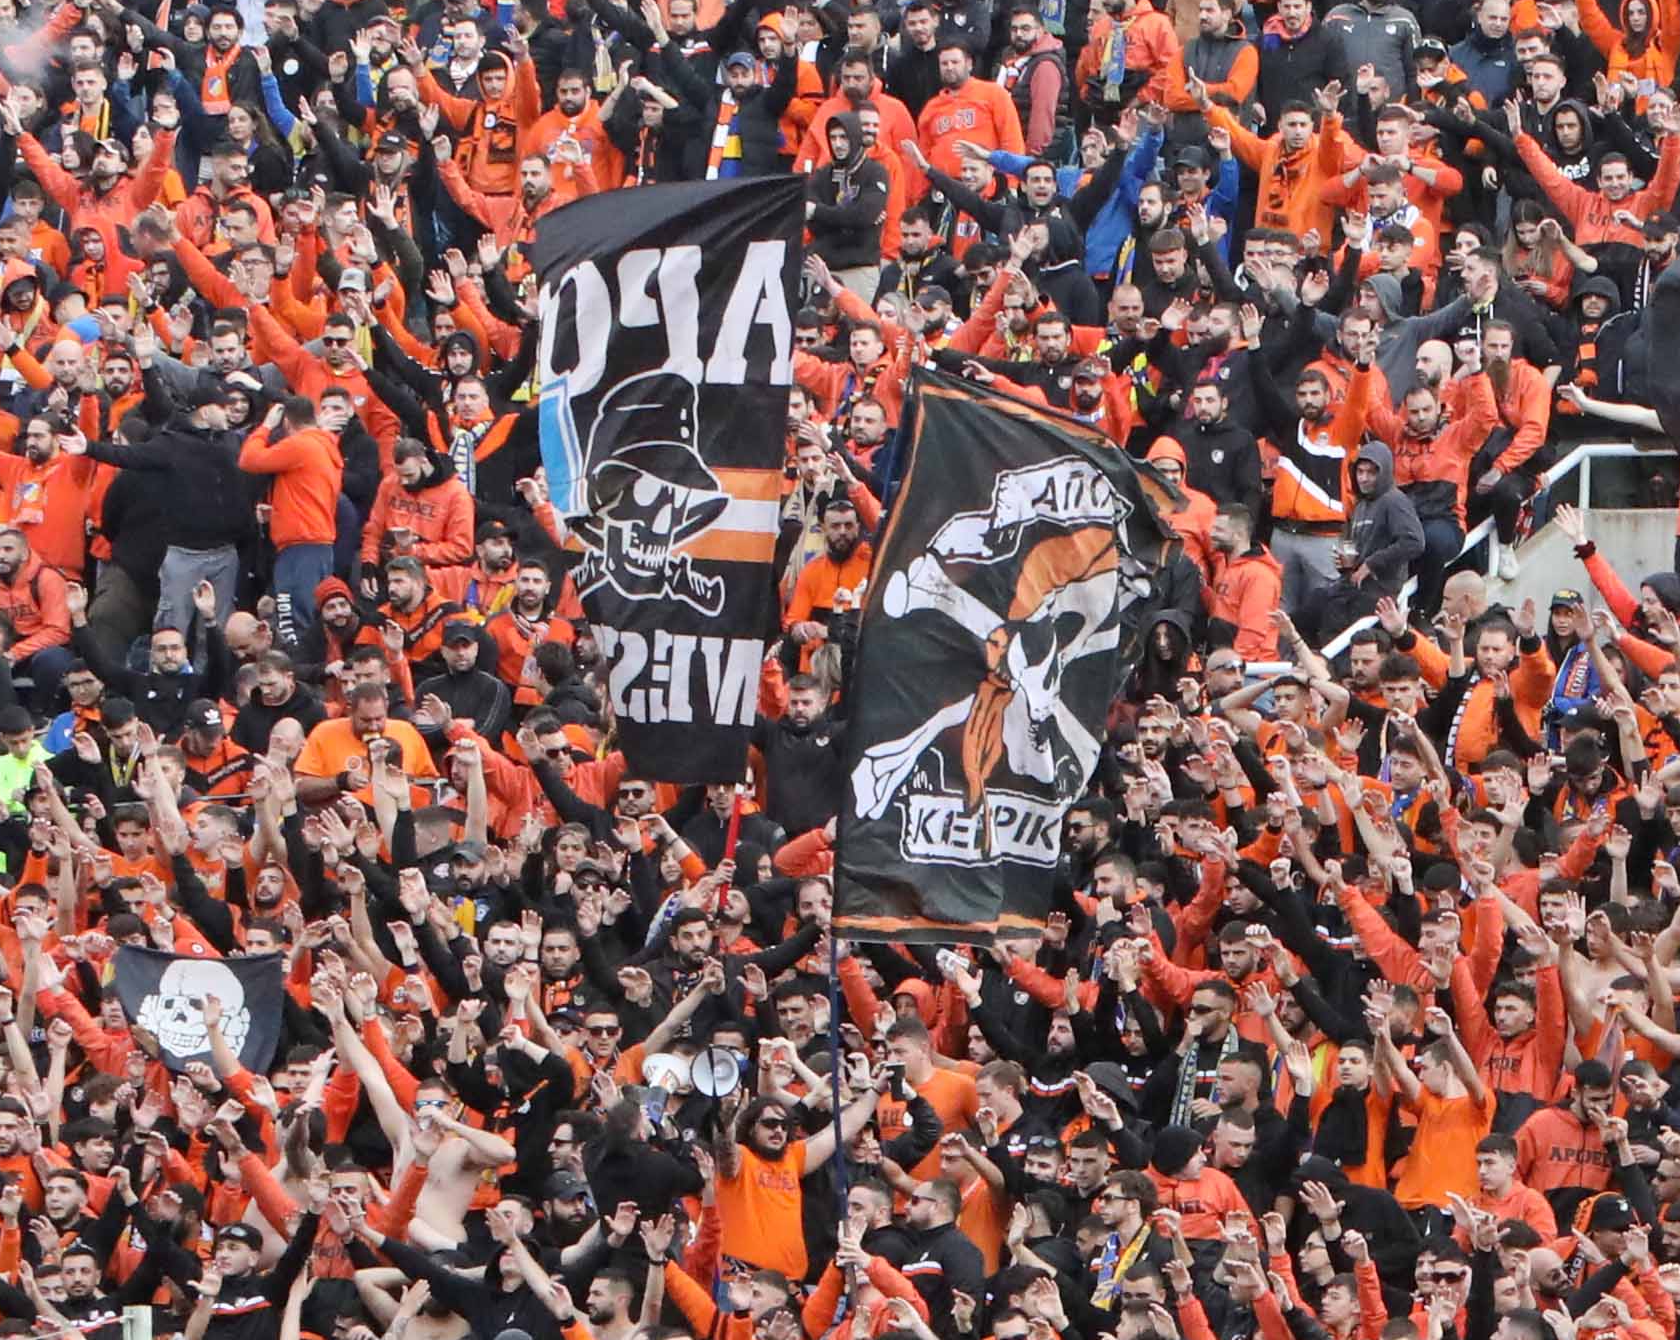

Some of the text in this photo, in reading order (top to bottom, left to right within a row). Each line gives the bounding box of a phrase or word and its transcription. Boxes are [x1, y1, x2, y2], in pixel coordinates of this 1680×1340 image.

[1034, 474, 1118, 518] ΑΠΟ
[278, 592, 302, 647] HOLLIS
[1550, 1145, 1611, 1165] APOEL
